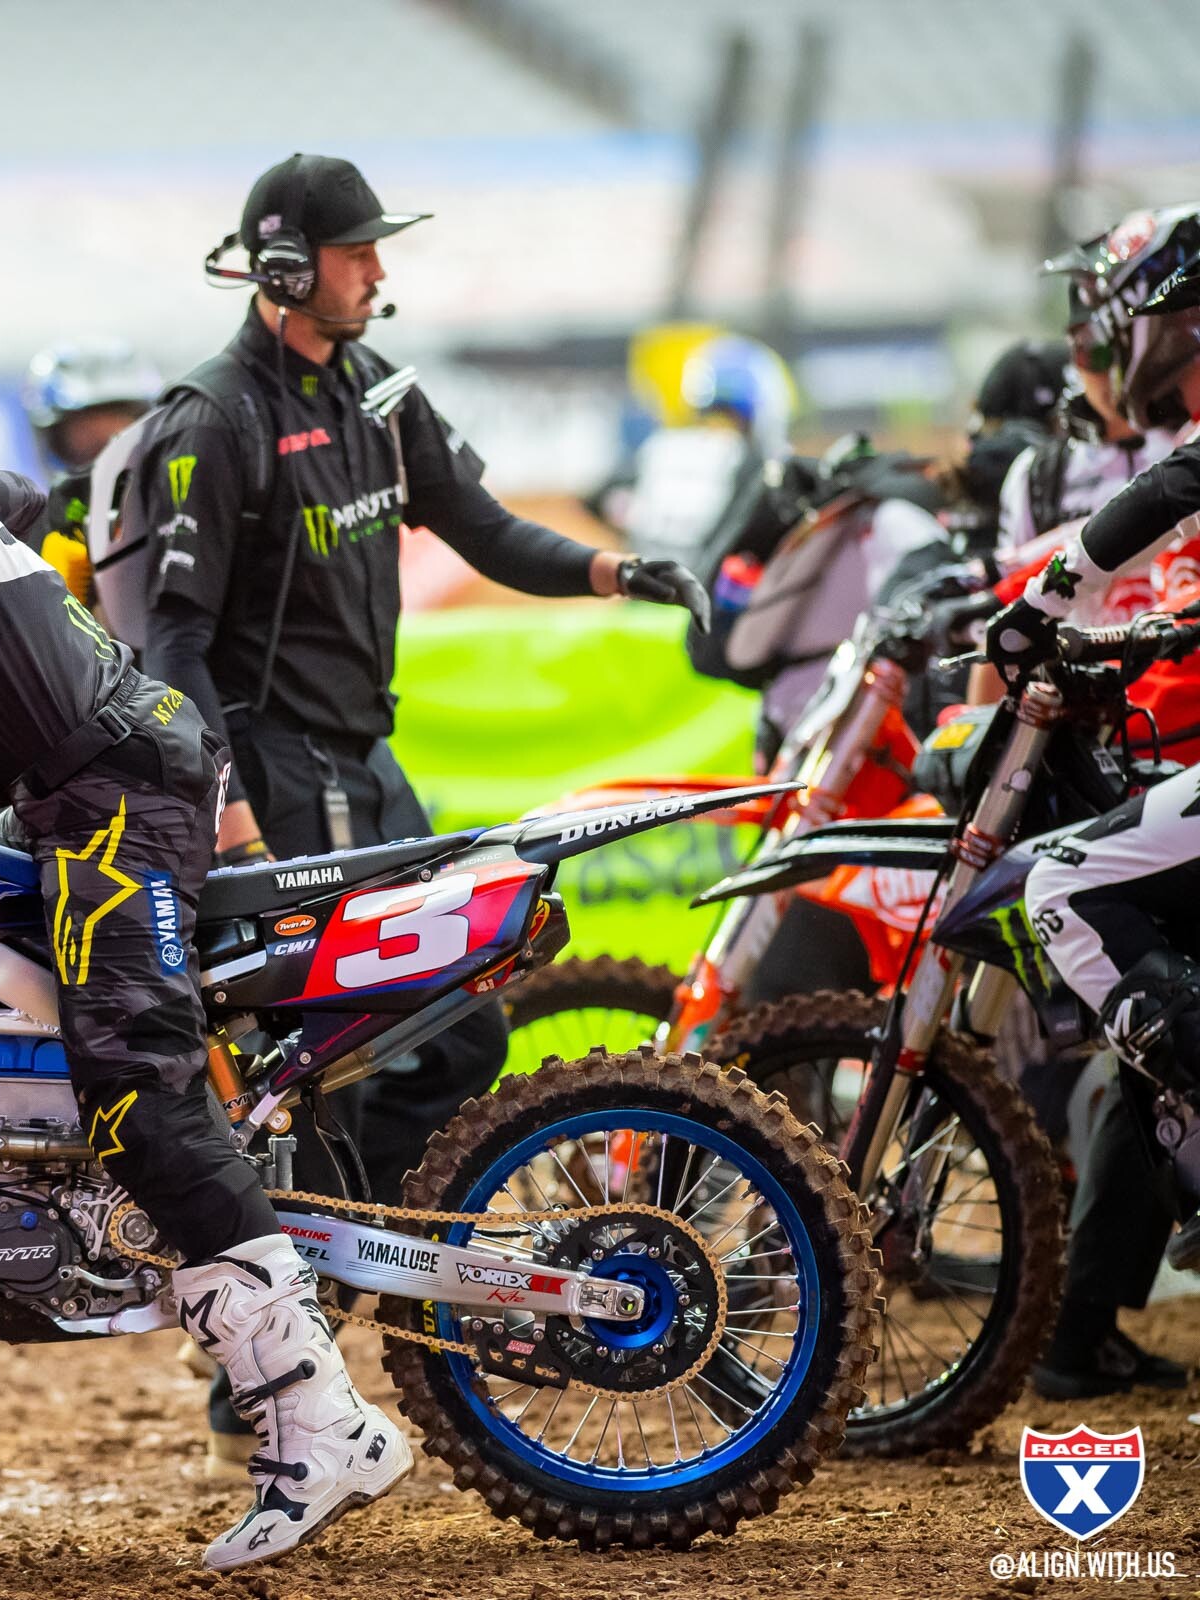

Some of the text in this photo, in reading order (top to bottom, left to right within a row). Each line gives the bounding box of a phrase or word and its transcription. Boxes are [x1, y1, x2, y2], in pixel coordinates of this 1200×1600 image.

[558, 797, 703, 845] DUNLOP
[462, 853, 502, 867] TOMAC
[275, 866, 344, 889] YAMAHA
[278, 919, 312, 932] Twin Air
[335, 873, 478, 989] 3
[280, 1224, 333, 1244] RAKING
[357, 1238, 441, 1274] YAMALUBE
[456, 1262, 534, 1291] VORTEX
[486, 1288, 527, 1304] Kite
